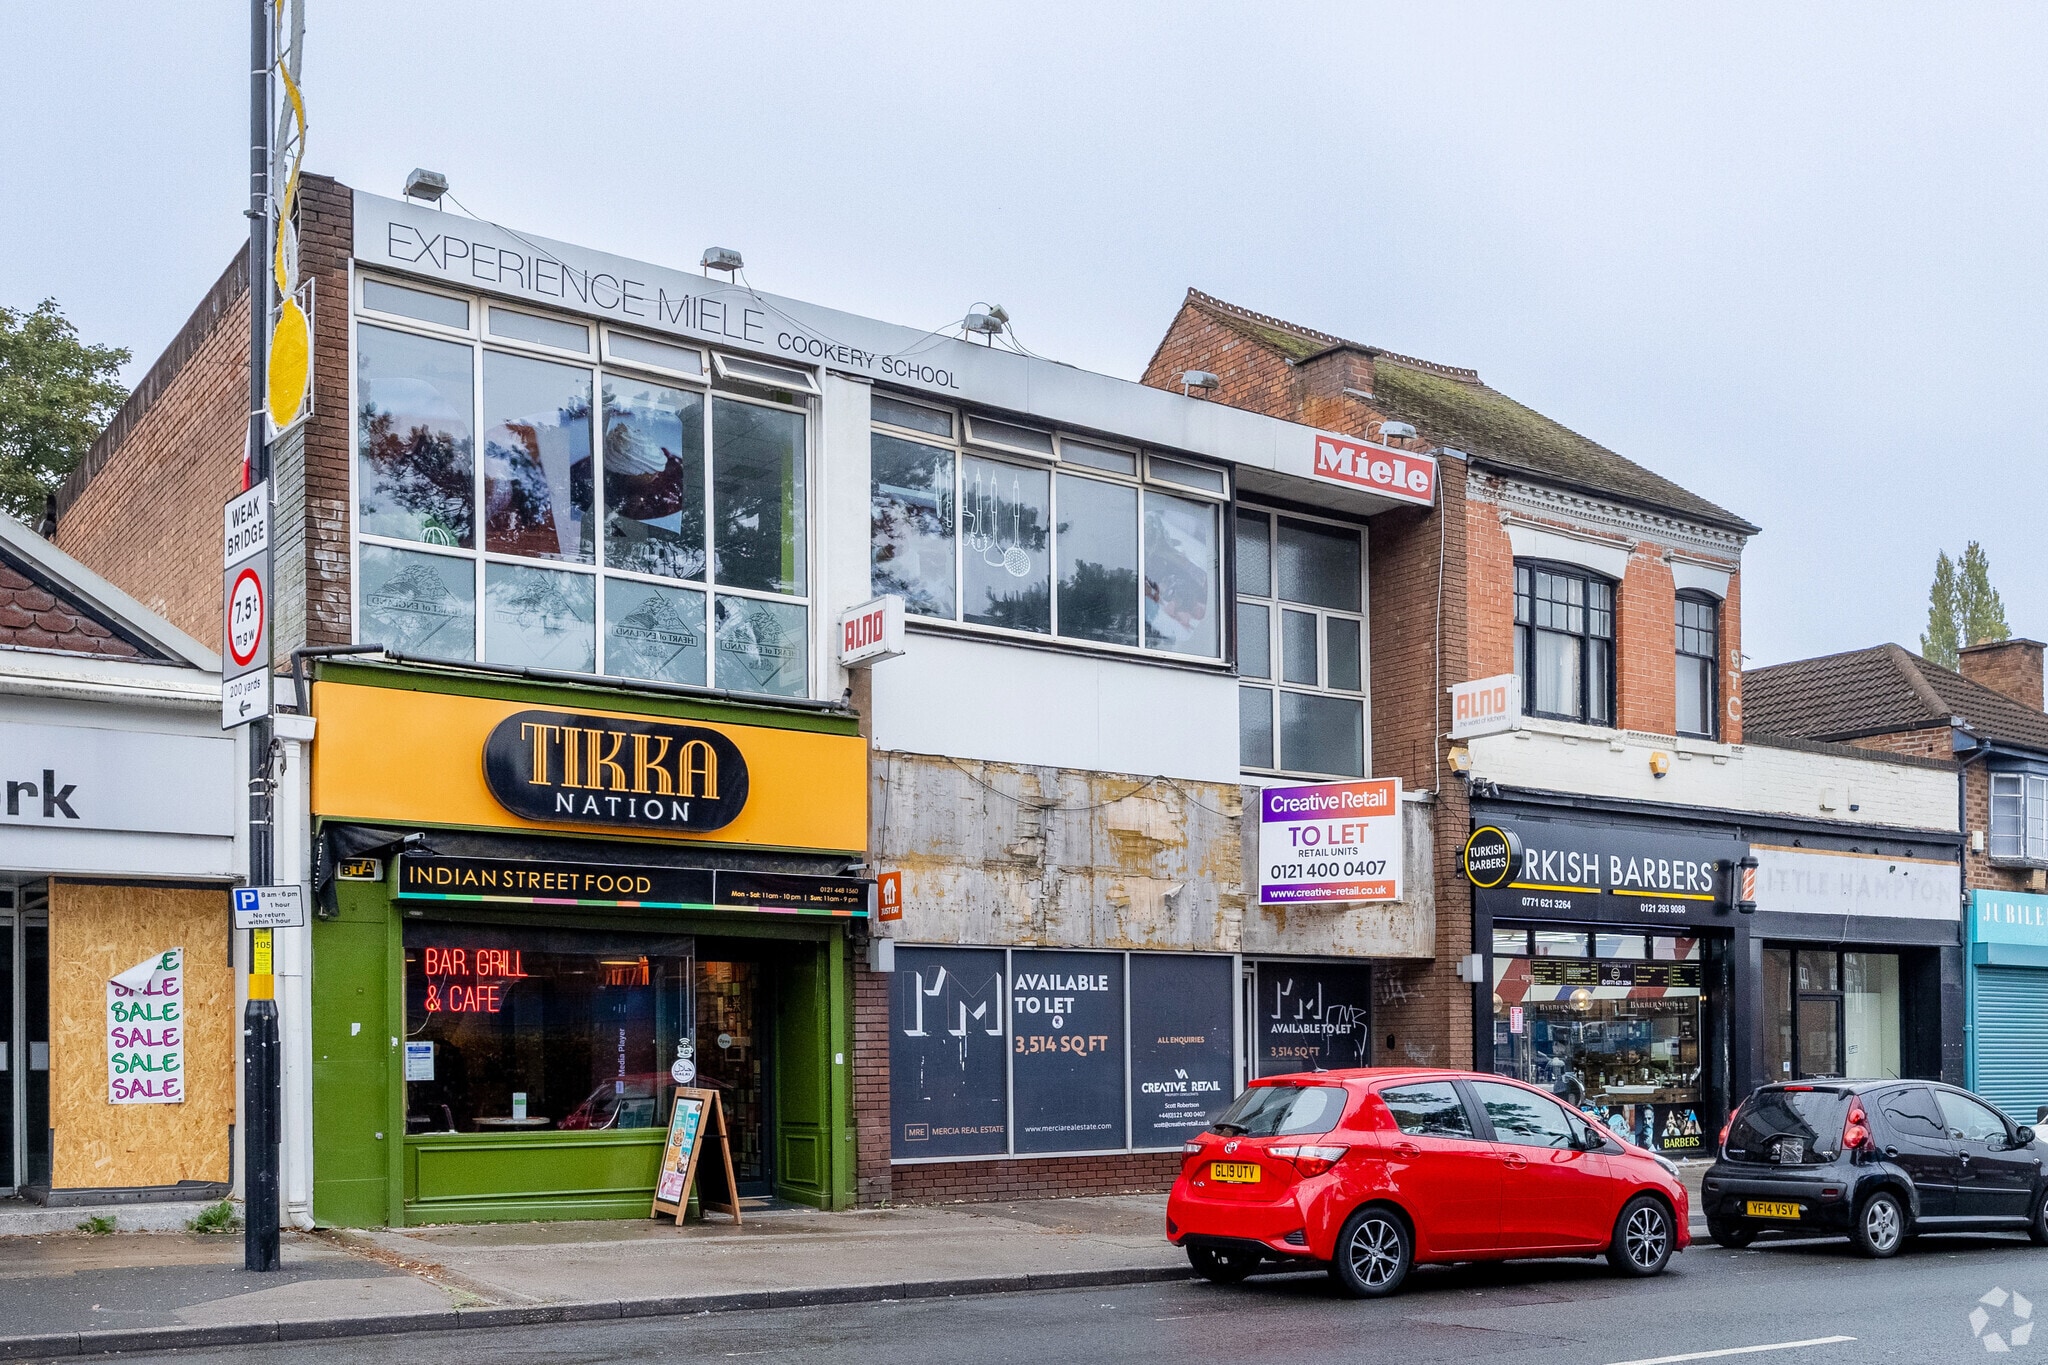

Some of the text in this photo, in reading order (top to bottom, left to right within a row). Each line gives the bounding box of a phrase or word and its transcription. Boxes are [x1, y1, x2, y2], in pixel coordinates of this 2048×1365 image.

[388, 222, 764, 344] EXPERIENCE MIELE
[777, 331, 960, 390] COOKERY SCHOOL
[1317, 441, 1429, 493] Miele
[232, 496, 260, 529] WEAK
[227, 520, 264, 557] BRIDGE
[845, 609, 883, 652] ALNO
[230, 679, 260, 698] 200 yards
[1457, 687, 1506, 720] ALNO
[521, 722, 720, 799] TIKKA
[0, 769, 80, 819] rk
[1271, 788, 1387, 813] Creative Retail
[555, 792, 690, 822] NATION
[1288, 823, 1369, 847] TO LET
[1299, 847, 1358, 858] RETAIL UNITS
[1470, 844, 1505, 857] TURKISH
[1271, 860, 1387, 879] 0121 400 0407
[1469, 857, 1506, 871] BARBERS
[1517, 848, 1713, 892] RKISH BARBERS
[409, 866, 650, 894] INDIAN STREET FOOD
[241, 892, 256, 909] P
[1270, 885, 1387, 898] www.creative-retail.co.uk
[881, 905, 900, 916] JUST EAT
[1522, 897, 1571, 910] 0771 621 3264
[1640, 903, 1686, 914] 0121 293 9088
[1983, 902, 2048, 926] JUBILE
[476, 949, 528, 977] GRILL
[1014, 974, 1109, 991] AVAILABLE
[425, 985, 499, 1012] & CAFE
[1014, 996, 1075, 1014] TO LET
[111, 1001, 179, 1022] SALE
[111, 1027, 180, 1048] SALE
[1271, 1023, 1352, 1034] AVAILABLE TO LET
[618, 1028, 627, 1052] Player
[1015, 1035, 1108, 1056] 3,514 SQ FT
[1157, 1035, 1205, 1045] ALL ENQUIRIES
[111, 1053, 180, 1074] SALE
[1271, 1047, 1293, 1059] 3,514
[1294, 1047, 1309, 1059] SQ
[618, 1054, 626, 1077] Media
[112, 1078, 180, 1099] SALE
[1141, 1081, 1221, 1094] CREATIVE RETAIL
[908, 1125, 1005, 1137] MRE MERCIA REAL ESTATE
[1024, 1123, 1112, 1133] www.merciarealestate.com
[1664, 1137, 1700, 1149] BARBERS
[1216, 1165, 1255, 1179] GL19 UTV
[1752, 1202, 1794, 1216] YF14 VSV
